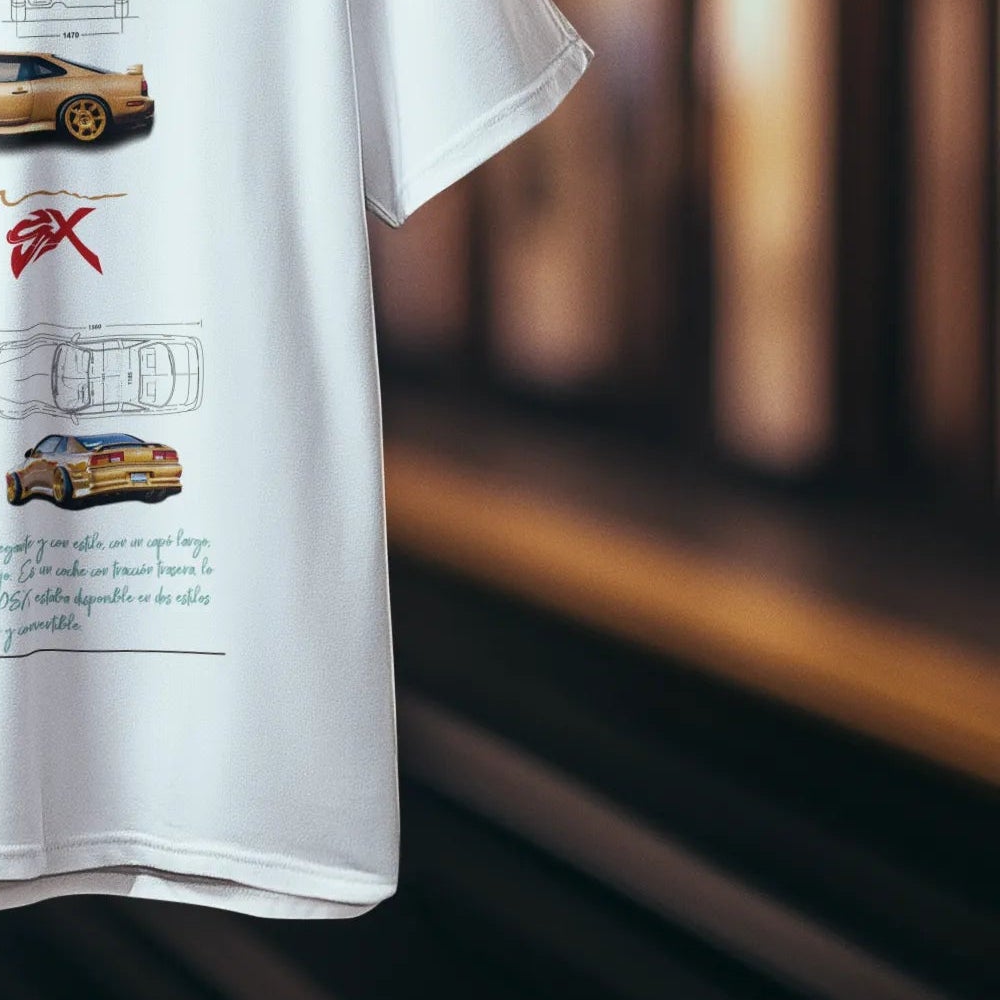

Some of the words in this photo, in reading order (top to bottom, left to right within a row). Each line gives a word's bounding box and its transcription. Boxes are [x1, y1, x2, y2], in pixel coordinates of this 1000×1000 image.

[36, 538, 48, 565] y
[50, 540, 69, 548] con
[72, 531, 105, 553] estilo,
[108, 538, 128, 549] con
[130, 538, 143, 548] un
[146, 534, 175, 560] capó
[176, 528, 212, 559] largo,
[17, 558, 36, 584] Es
[39, 565, 54, 576] un
[55, 559, 87, 577] coche
[89, 567, 110, 578] con
[111, 559, 154, 580] tracción
[201, 556, 214, 576] lo
[34, 586, 71, 606] estaba
[73, 584, 135, 618] disponible
[137, 593, 152, 603] en
[154, 585, 172, 606] dos
[175, 584, 211, 607] estilos
[4, 627, 15, 654] y
